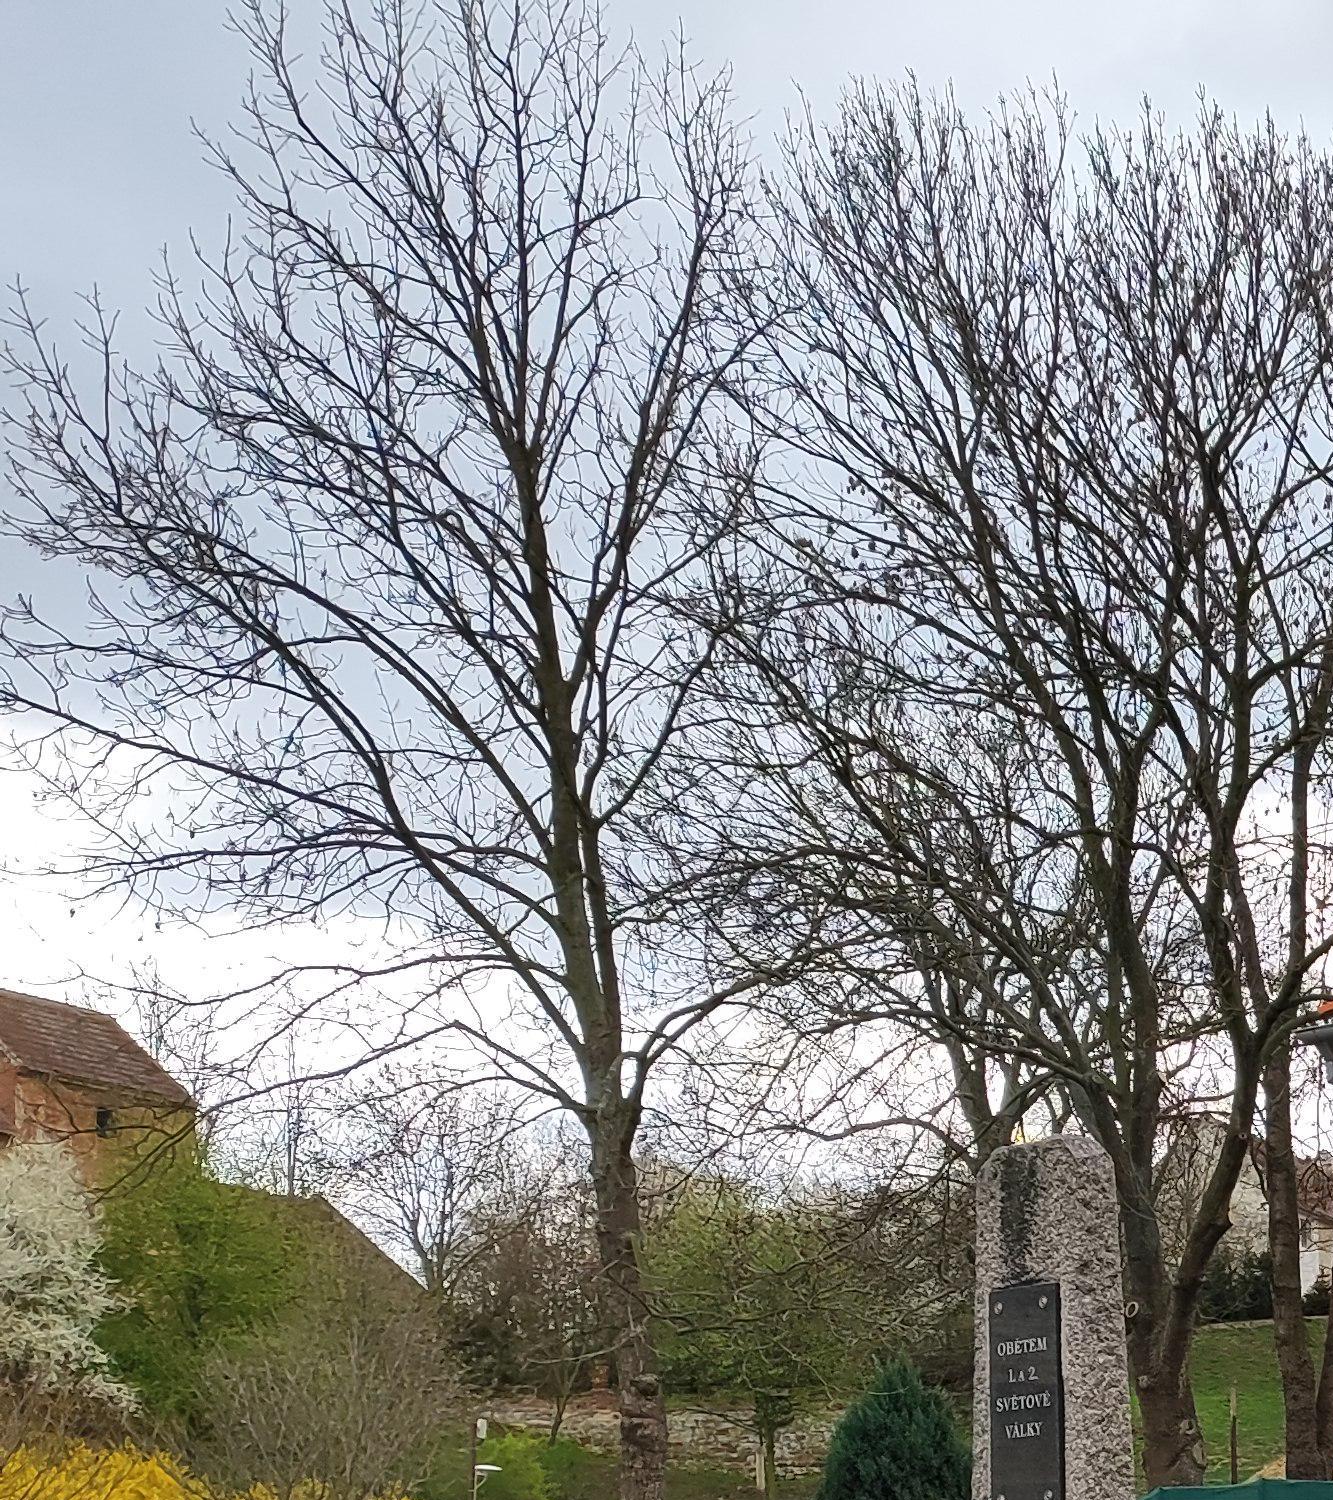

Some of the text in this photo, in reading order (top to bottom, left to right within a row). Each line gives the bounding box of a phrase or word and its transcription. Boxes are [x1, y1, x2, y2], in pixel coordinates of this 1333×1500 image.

[997, 1336, 1048, 1357] OBĚTEM
[996, 1390, 1051, 1413] SVĚTOVÉ
[1005, 1421, 1042, 1439] VÁLKY
